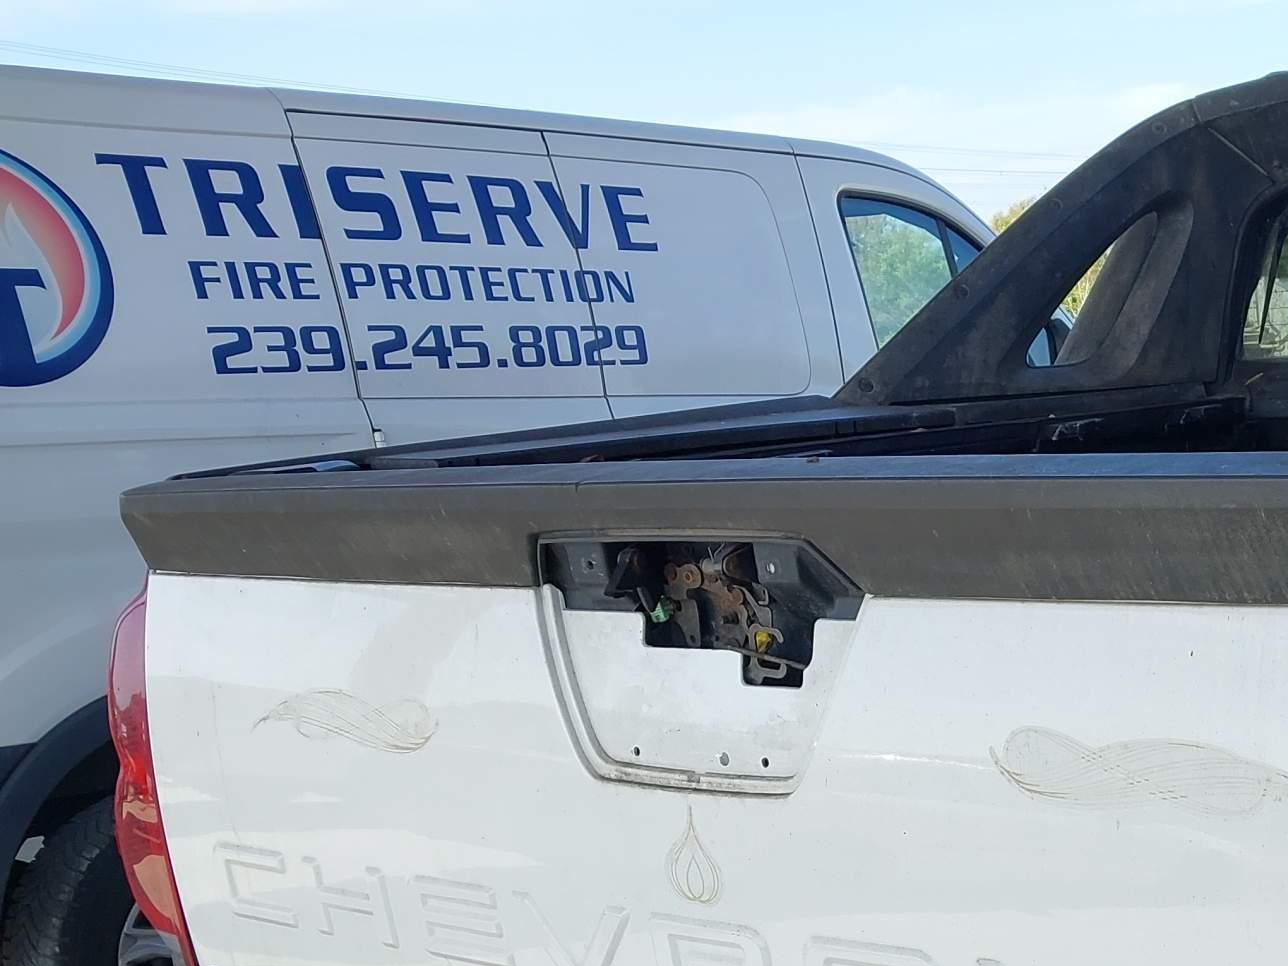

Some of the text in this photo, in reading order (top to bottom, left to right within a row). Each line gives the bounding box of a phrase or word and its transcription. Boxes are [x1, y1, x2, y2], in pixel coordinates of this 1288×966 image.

[94, 152, 659, 252] TRISERVE
[187, 260, 636, 304] FIRE PROTECTION
[206, 324, 649, 375] 239.245.8029
